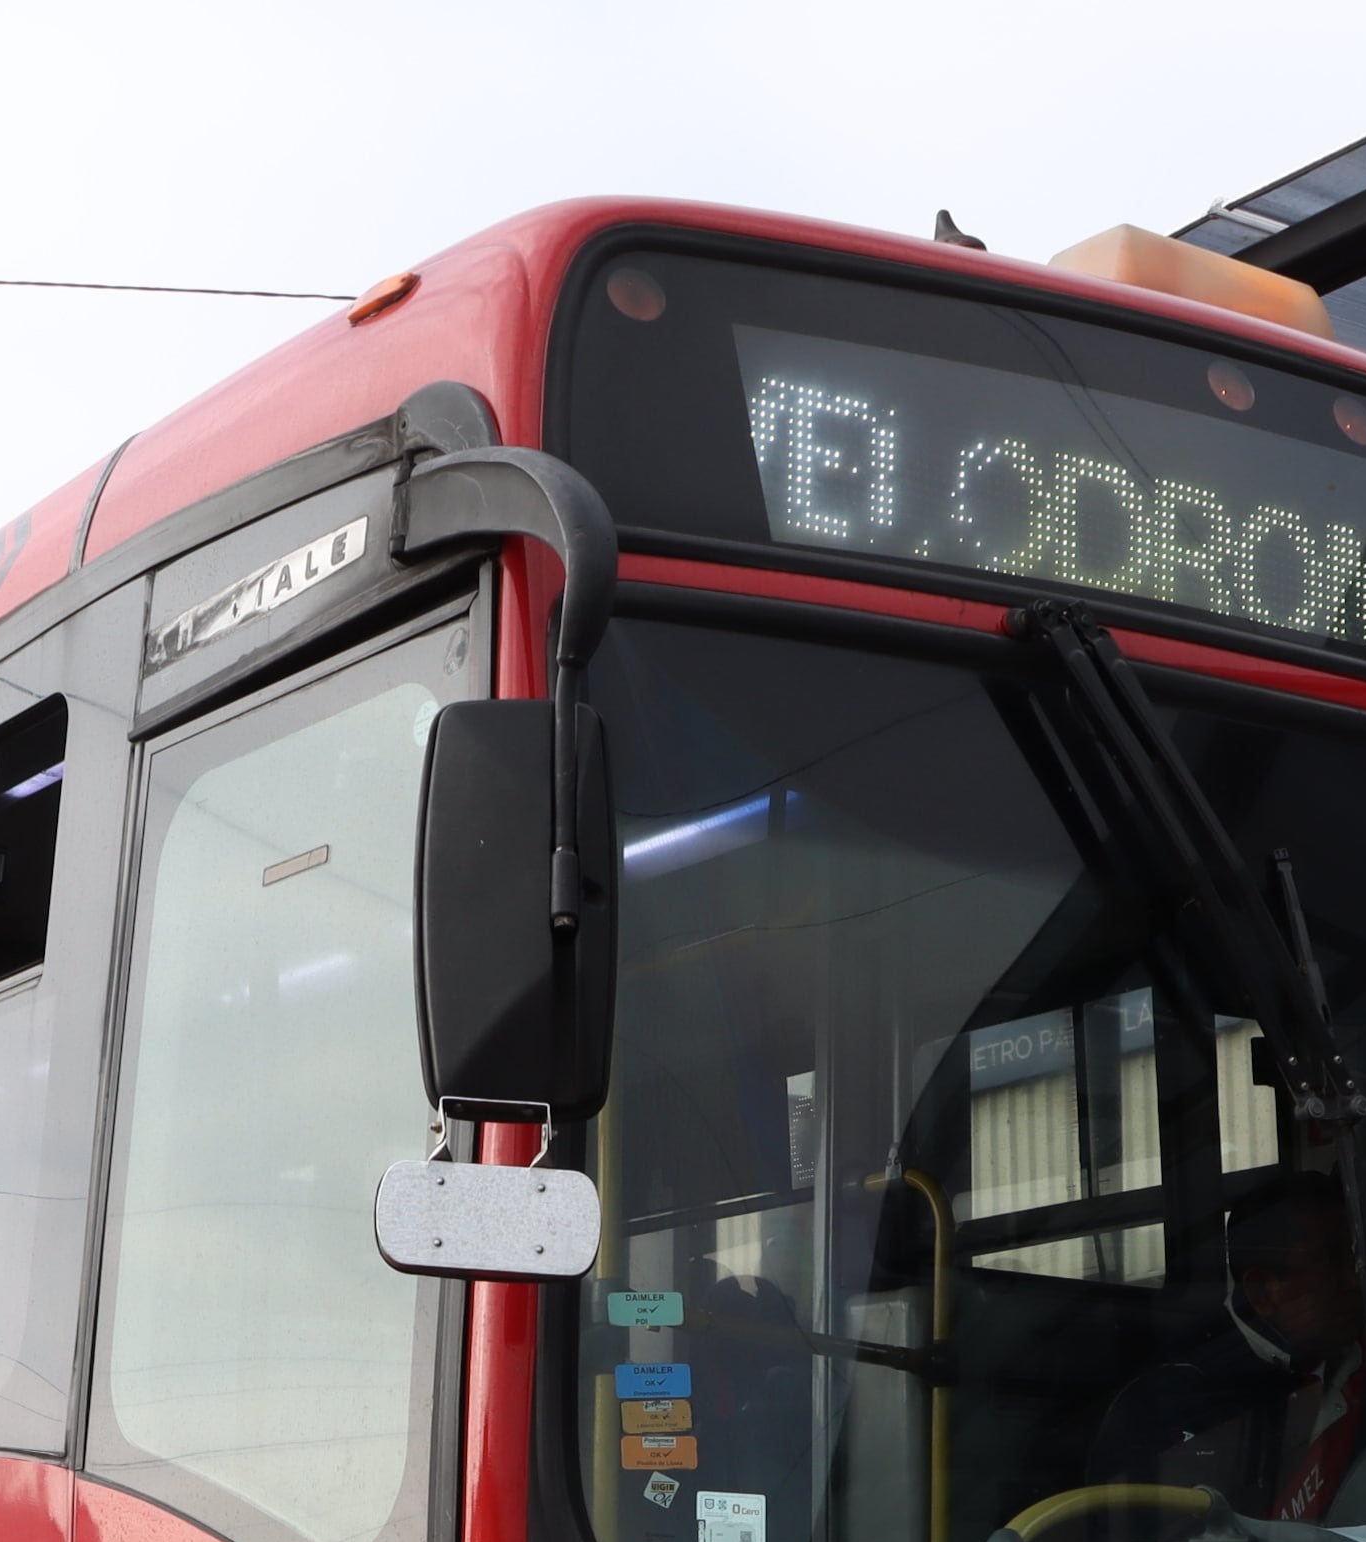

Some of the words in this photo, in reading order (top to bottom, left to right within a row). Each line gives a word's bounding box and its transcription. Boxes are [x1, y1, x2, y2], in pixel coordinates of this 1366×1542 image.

[970, 1035, 1033, 1071] ETRO
[625, 1294, 665, 1302] DAIMLER
[633, 1366, 673, 1375] DAIMLER
